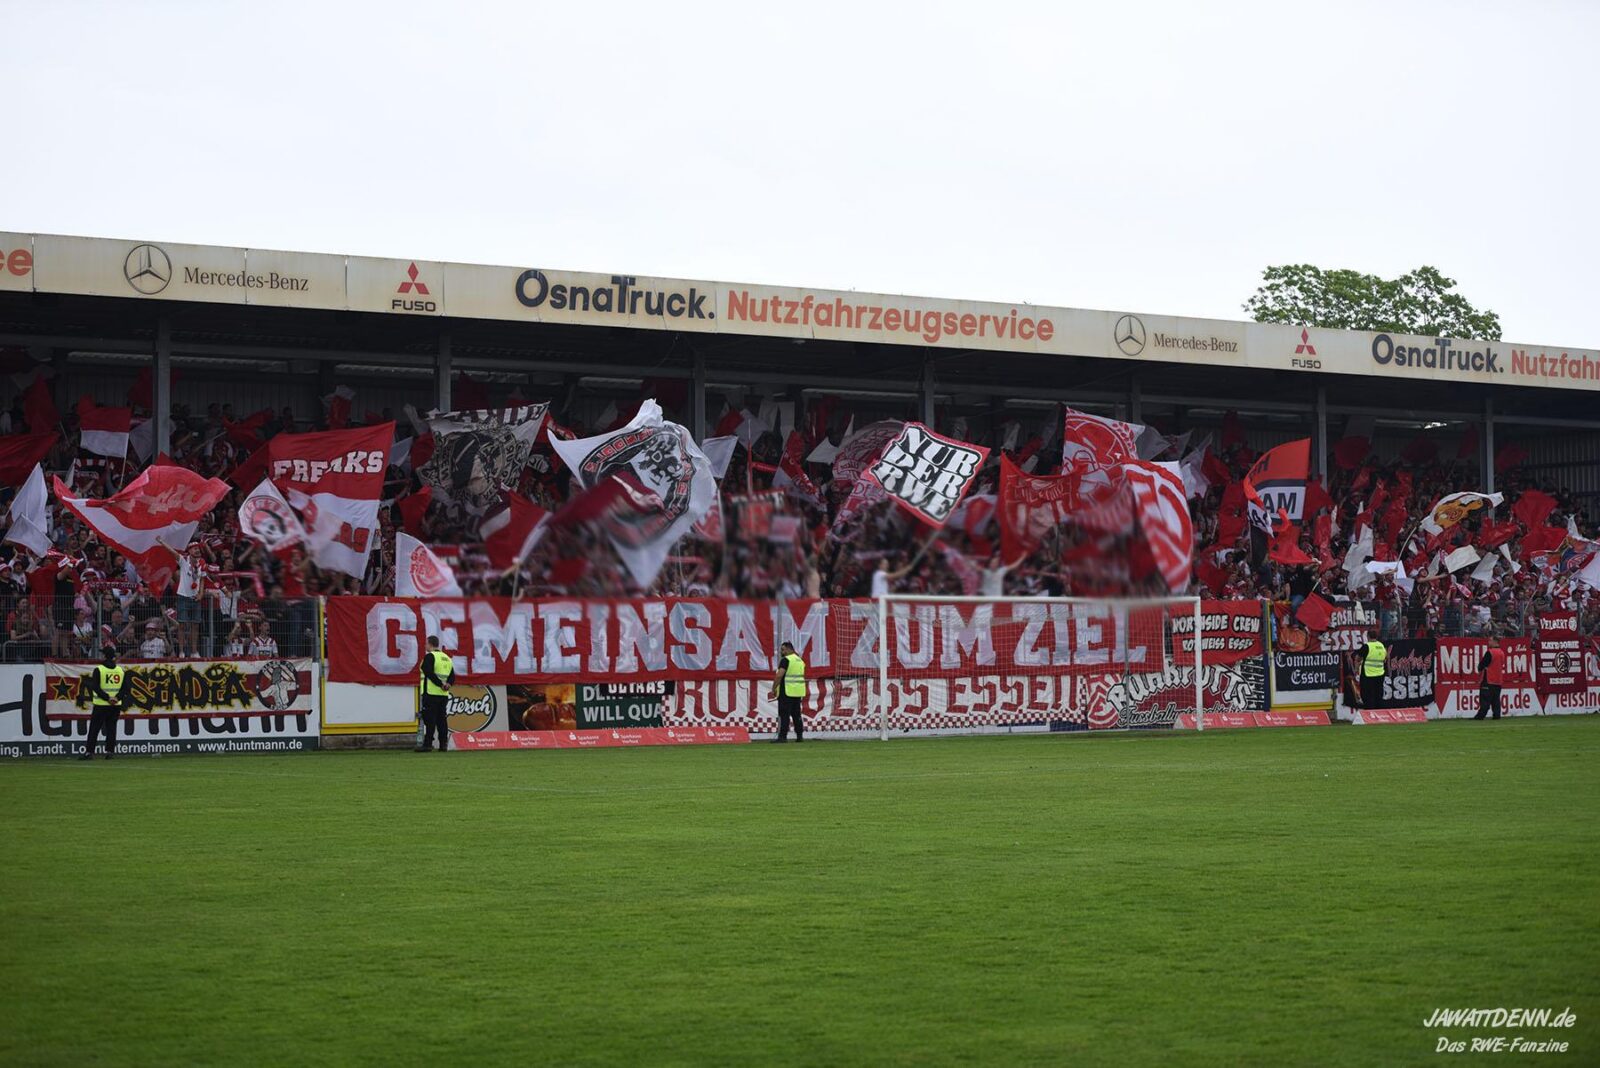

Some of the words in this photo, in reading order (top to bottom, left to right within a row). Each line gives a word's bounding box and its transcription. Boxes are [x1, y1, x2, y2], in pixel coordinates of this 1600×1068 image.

[184, 265, 308, 292] Mercedes-Benz
[392, 299, 436, 312] FUSO
[514, 268, 715, 320] OsnaTruck.
[728, 290, 1055, 344] Nutzfahrzeugservice
[1153, 331, 1238, 353] Mercedes-Benz
[1291, 357, 1322, 370] FUSO
[1371, 333, 1504, 374] OsnaTruck.
[900, 427, 980, 478] NUR
[272, 450, 384, 483] FREAKS
[1173, 614, 1229, 634] NORHSIDE
[1232, 616, 1260, 633] CREW
[366, 600, 831, 676] GEMEINSAM
[850, 600, 997, 670] ZUM
[1013, 602, 1147, 668] ZIEL
[1276, 652, 1340, 668] Commando
[105, 674, 121, 684] K9
[1290, 669, 1327, 685] Essen
[1382, 673, 1434, 701] SSEN
[583, 704, 626, 723] WILL
[627, 703, 663, 722] QUA
[29, 743, 66, 755] Landt.
[197, 739, 303, 752] www.huntmann.de
